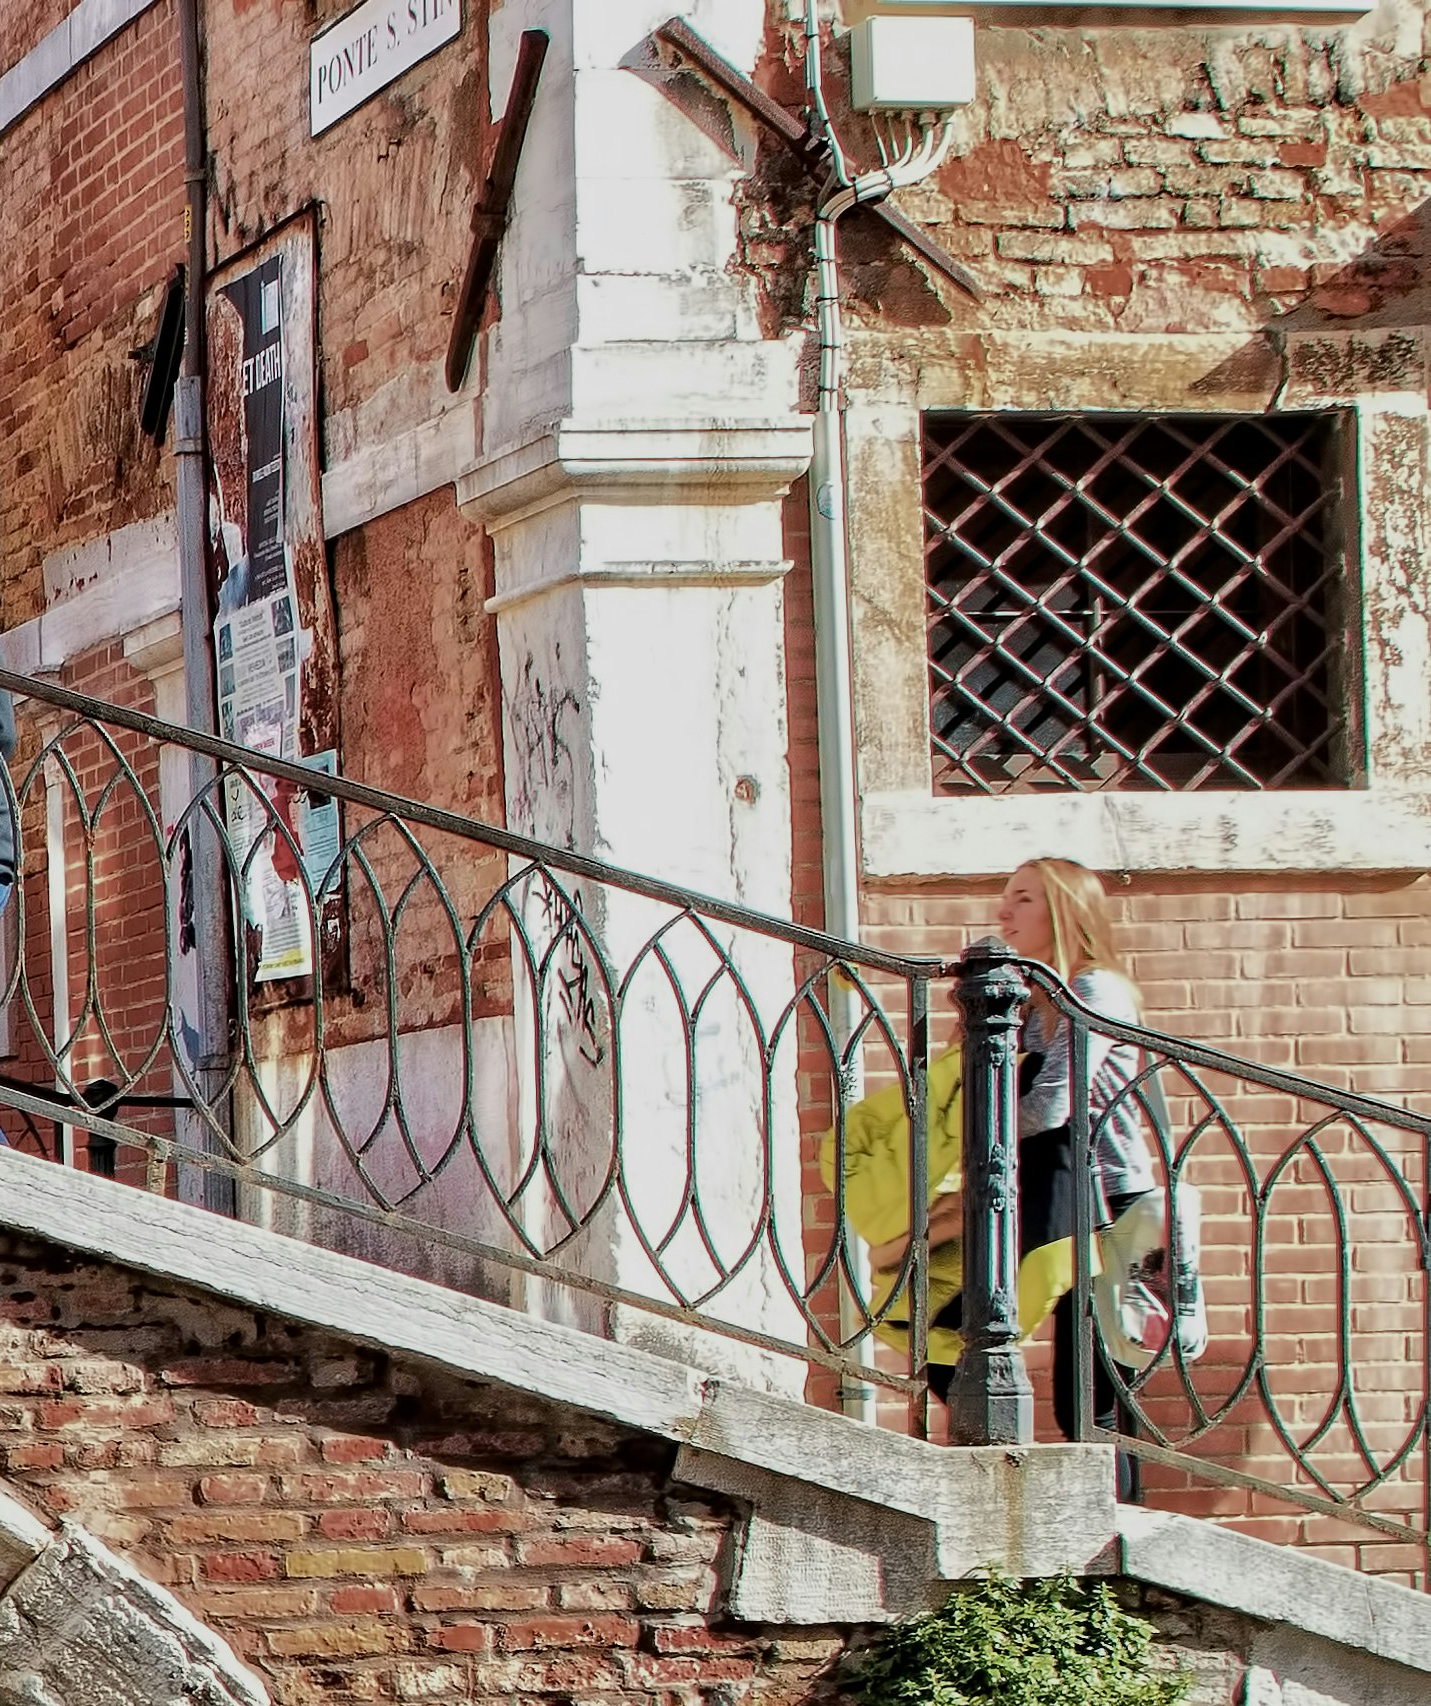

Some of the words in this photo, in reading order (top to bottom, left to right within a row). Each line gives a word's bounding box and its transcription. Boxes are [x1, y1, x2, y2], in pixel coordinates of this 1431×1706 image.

[318, 25, 378, 104] PONTE
[387, 12, 400, 50] S.
[255, 341, 281, 391] DEATH
